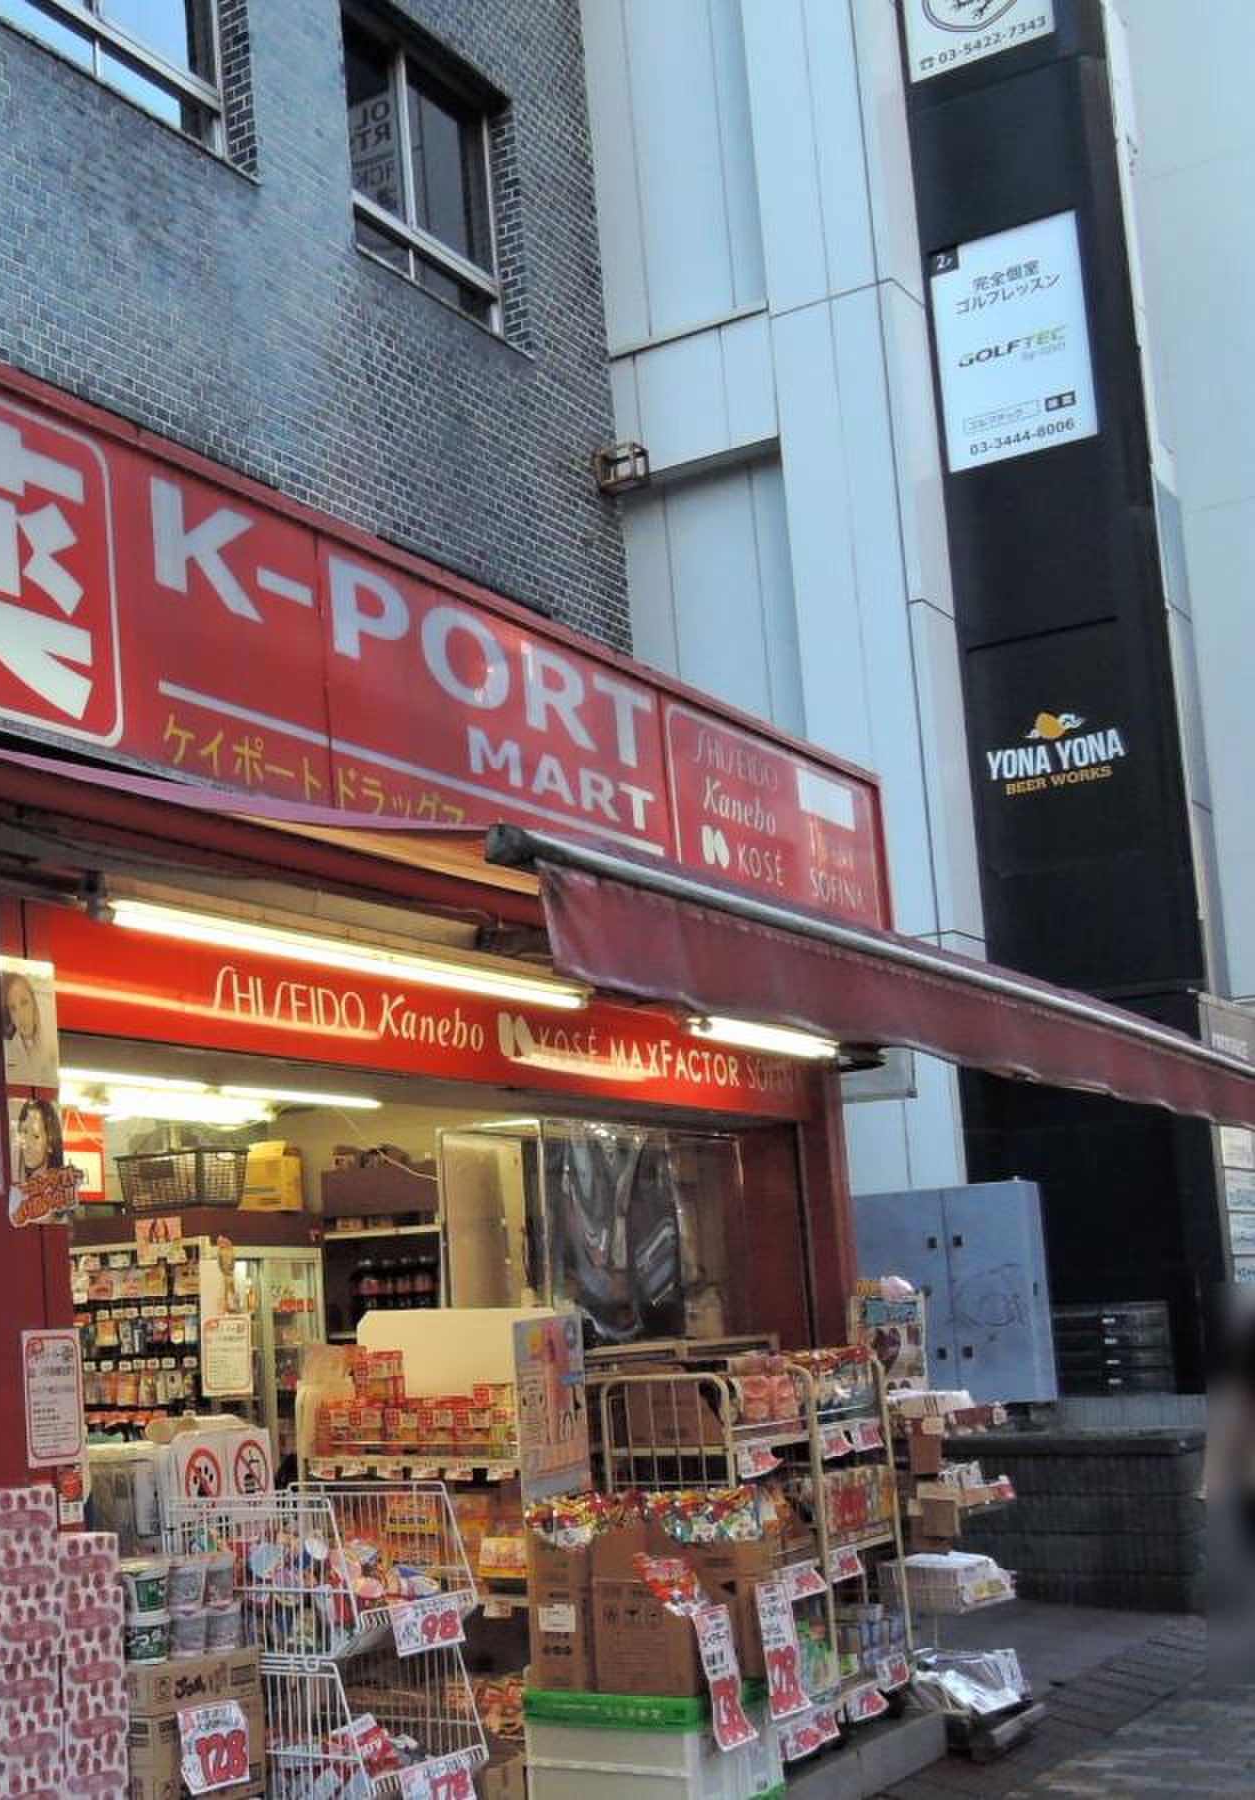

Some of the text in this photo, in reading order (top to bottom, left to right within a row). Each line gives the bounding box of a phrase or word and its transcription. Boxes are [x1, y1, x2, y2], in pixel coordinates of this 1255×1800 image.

[955, 274, 1060, 314] ゴルフレッスン
[149, 474, 652, 768] K-PORT
[468, 726, 654, 829] MART
[987, 727, 1125, 781] YONA YONA
[1006, 766, 1113, 796] BEER WORKS
[703, 776, 776, 837] Kanebo
[213, 965, 367, 1032] SHISEIDO
[378, 993, 484, 1052] Kanebo
